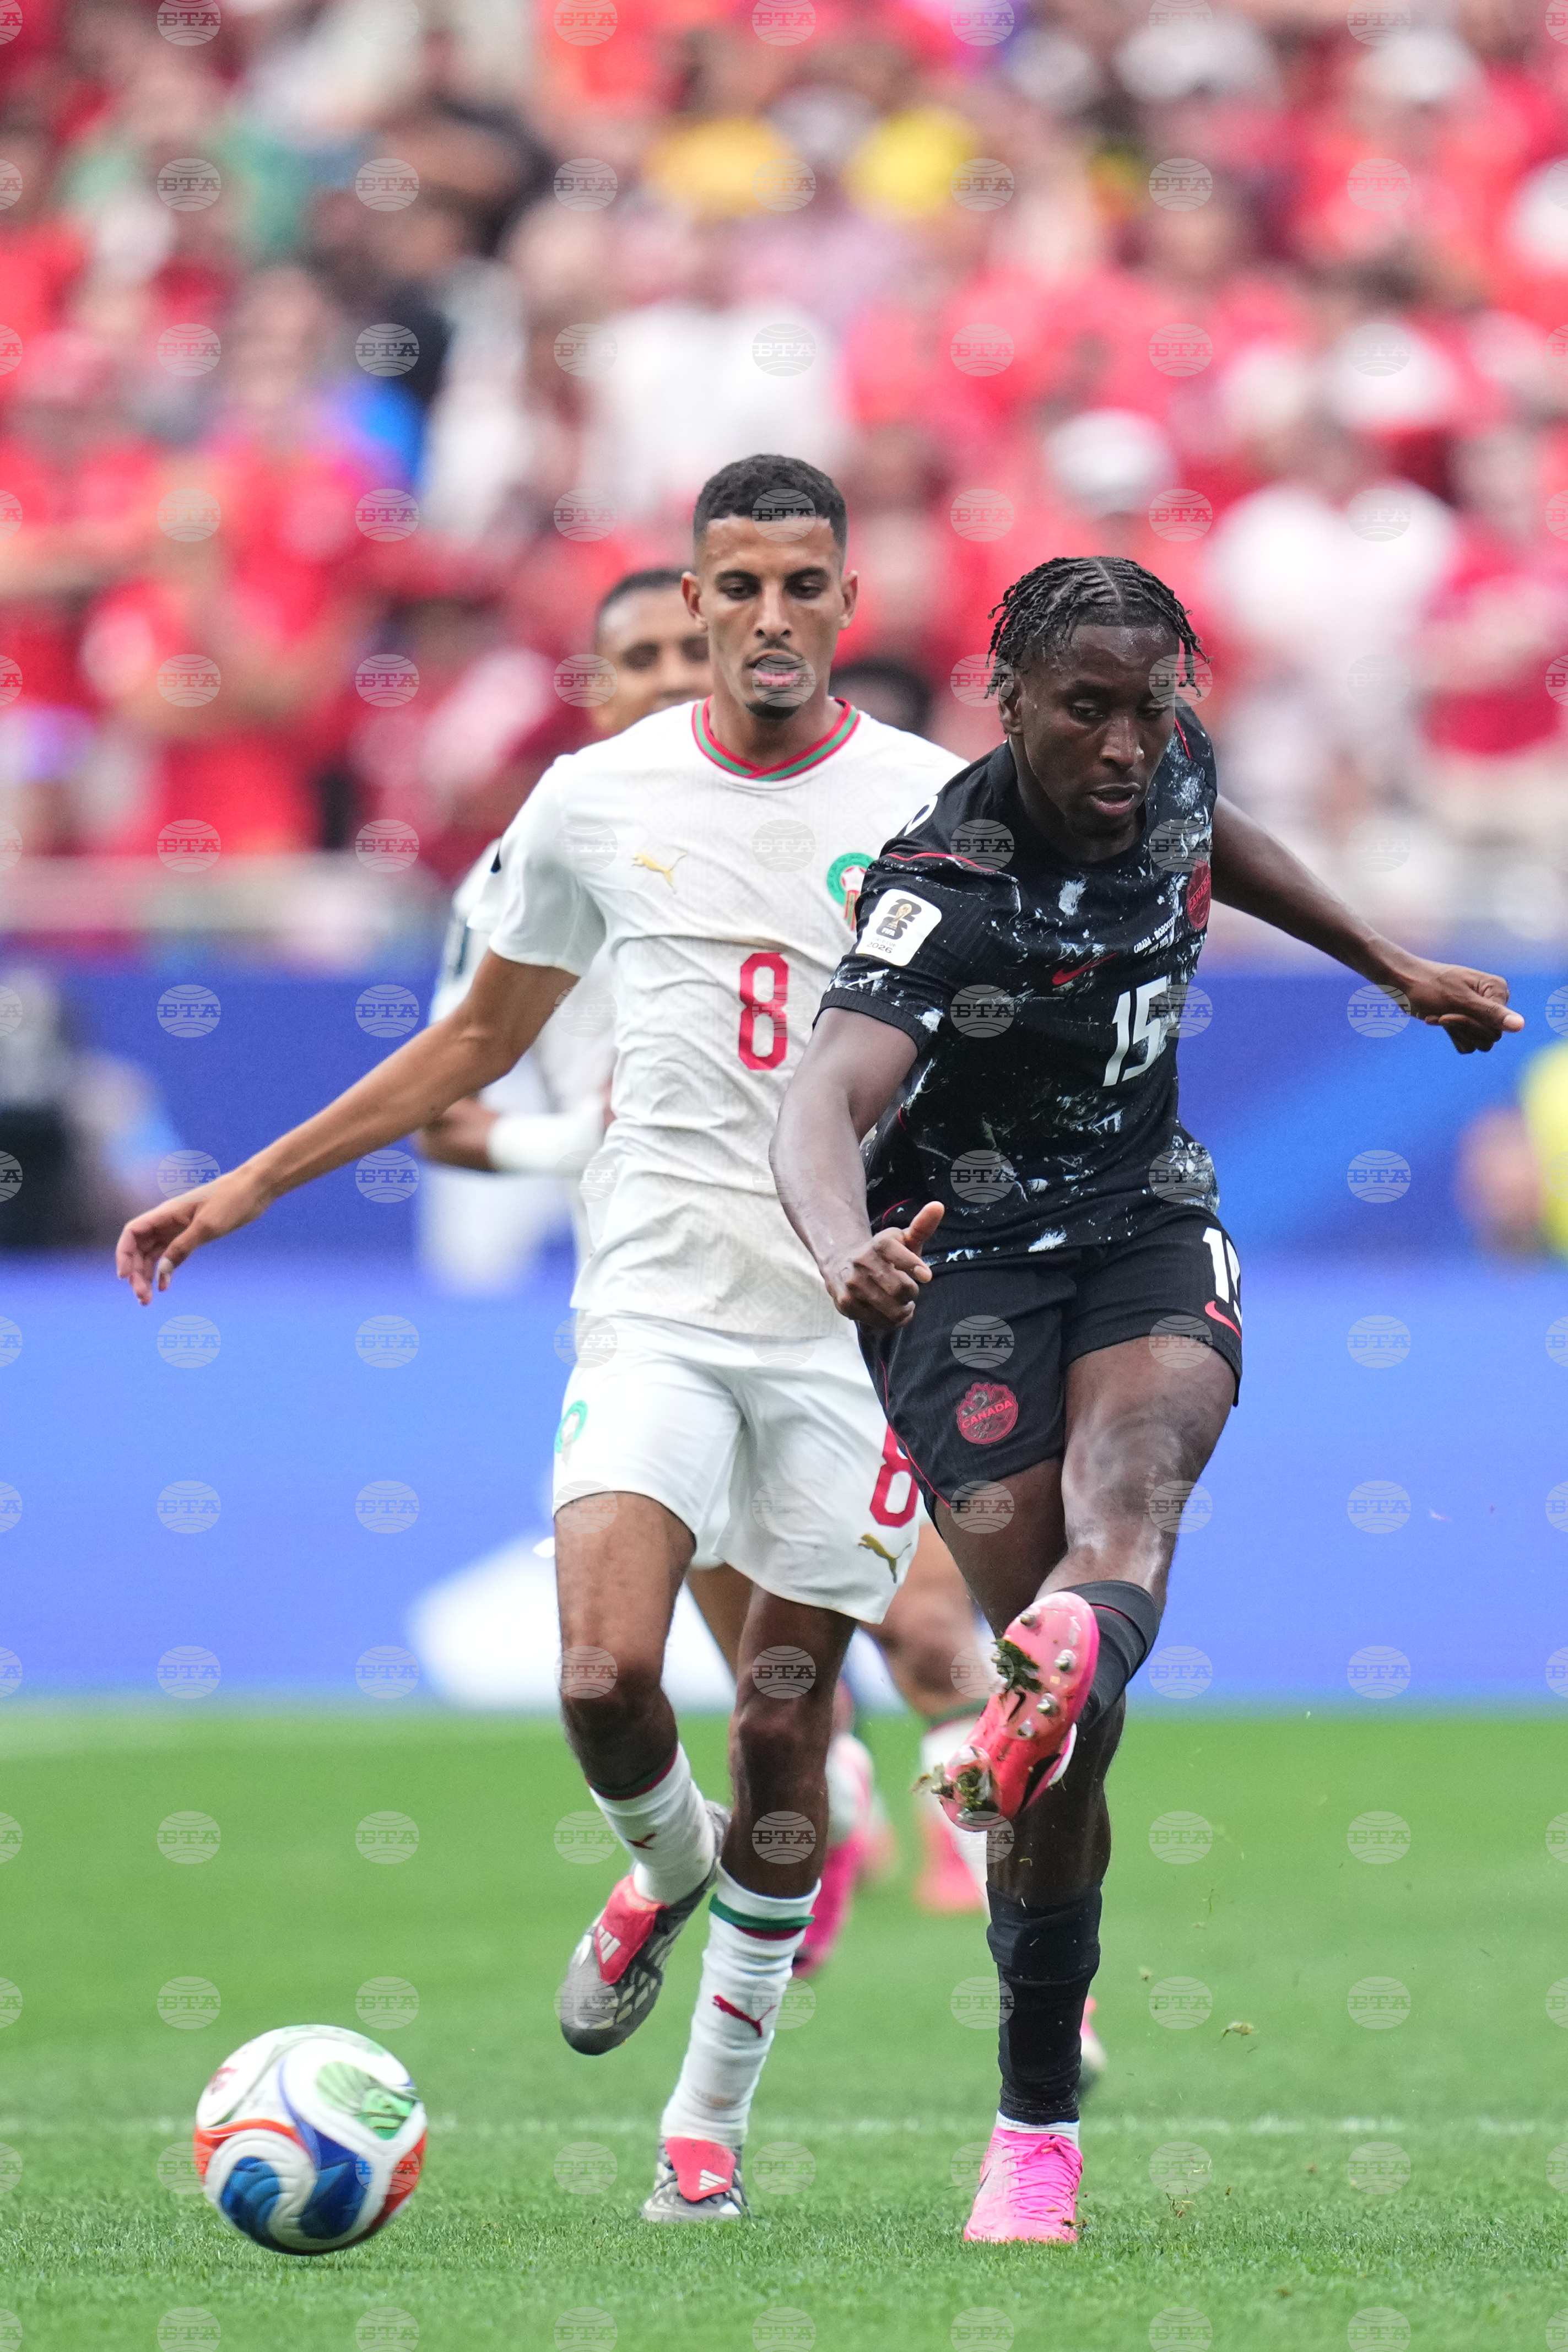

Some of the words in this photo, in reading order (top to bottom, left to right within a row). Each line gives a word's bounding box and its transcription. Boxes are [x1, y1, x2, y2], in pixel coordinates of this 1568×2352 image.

[867, 942, 893, 954] 2026
[882, 927, 895, 936] FIFA
[1134, 937, 1151, 953] CANADA
[1154, 917, 1174, 940] MOROCCO
[739, 952, 789, 1070] 8
[1102, 976, 1167, 1086] 15
[962, 1400, 1013, 1429] CANADA
[870, 1423, 918, 1528] 8
